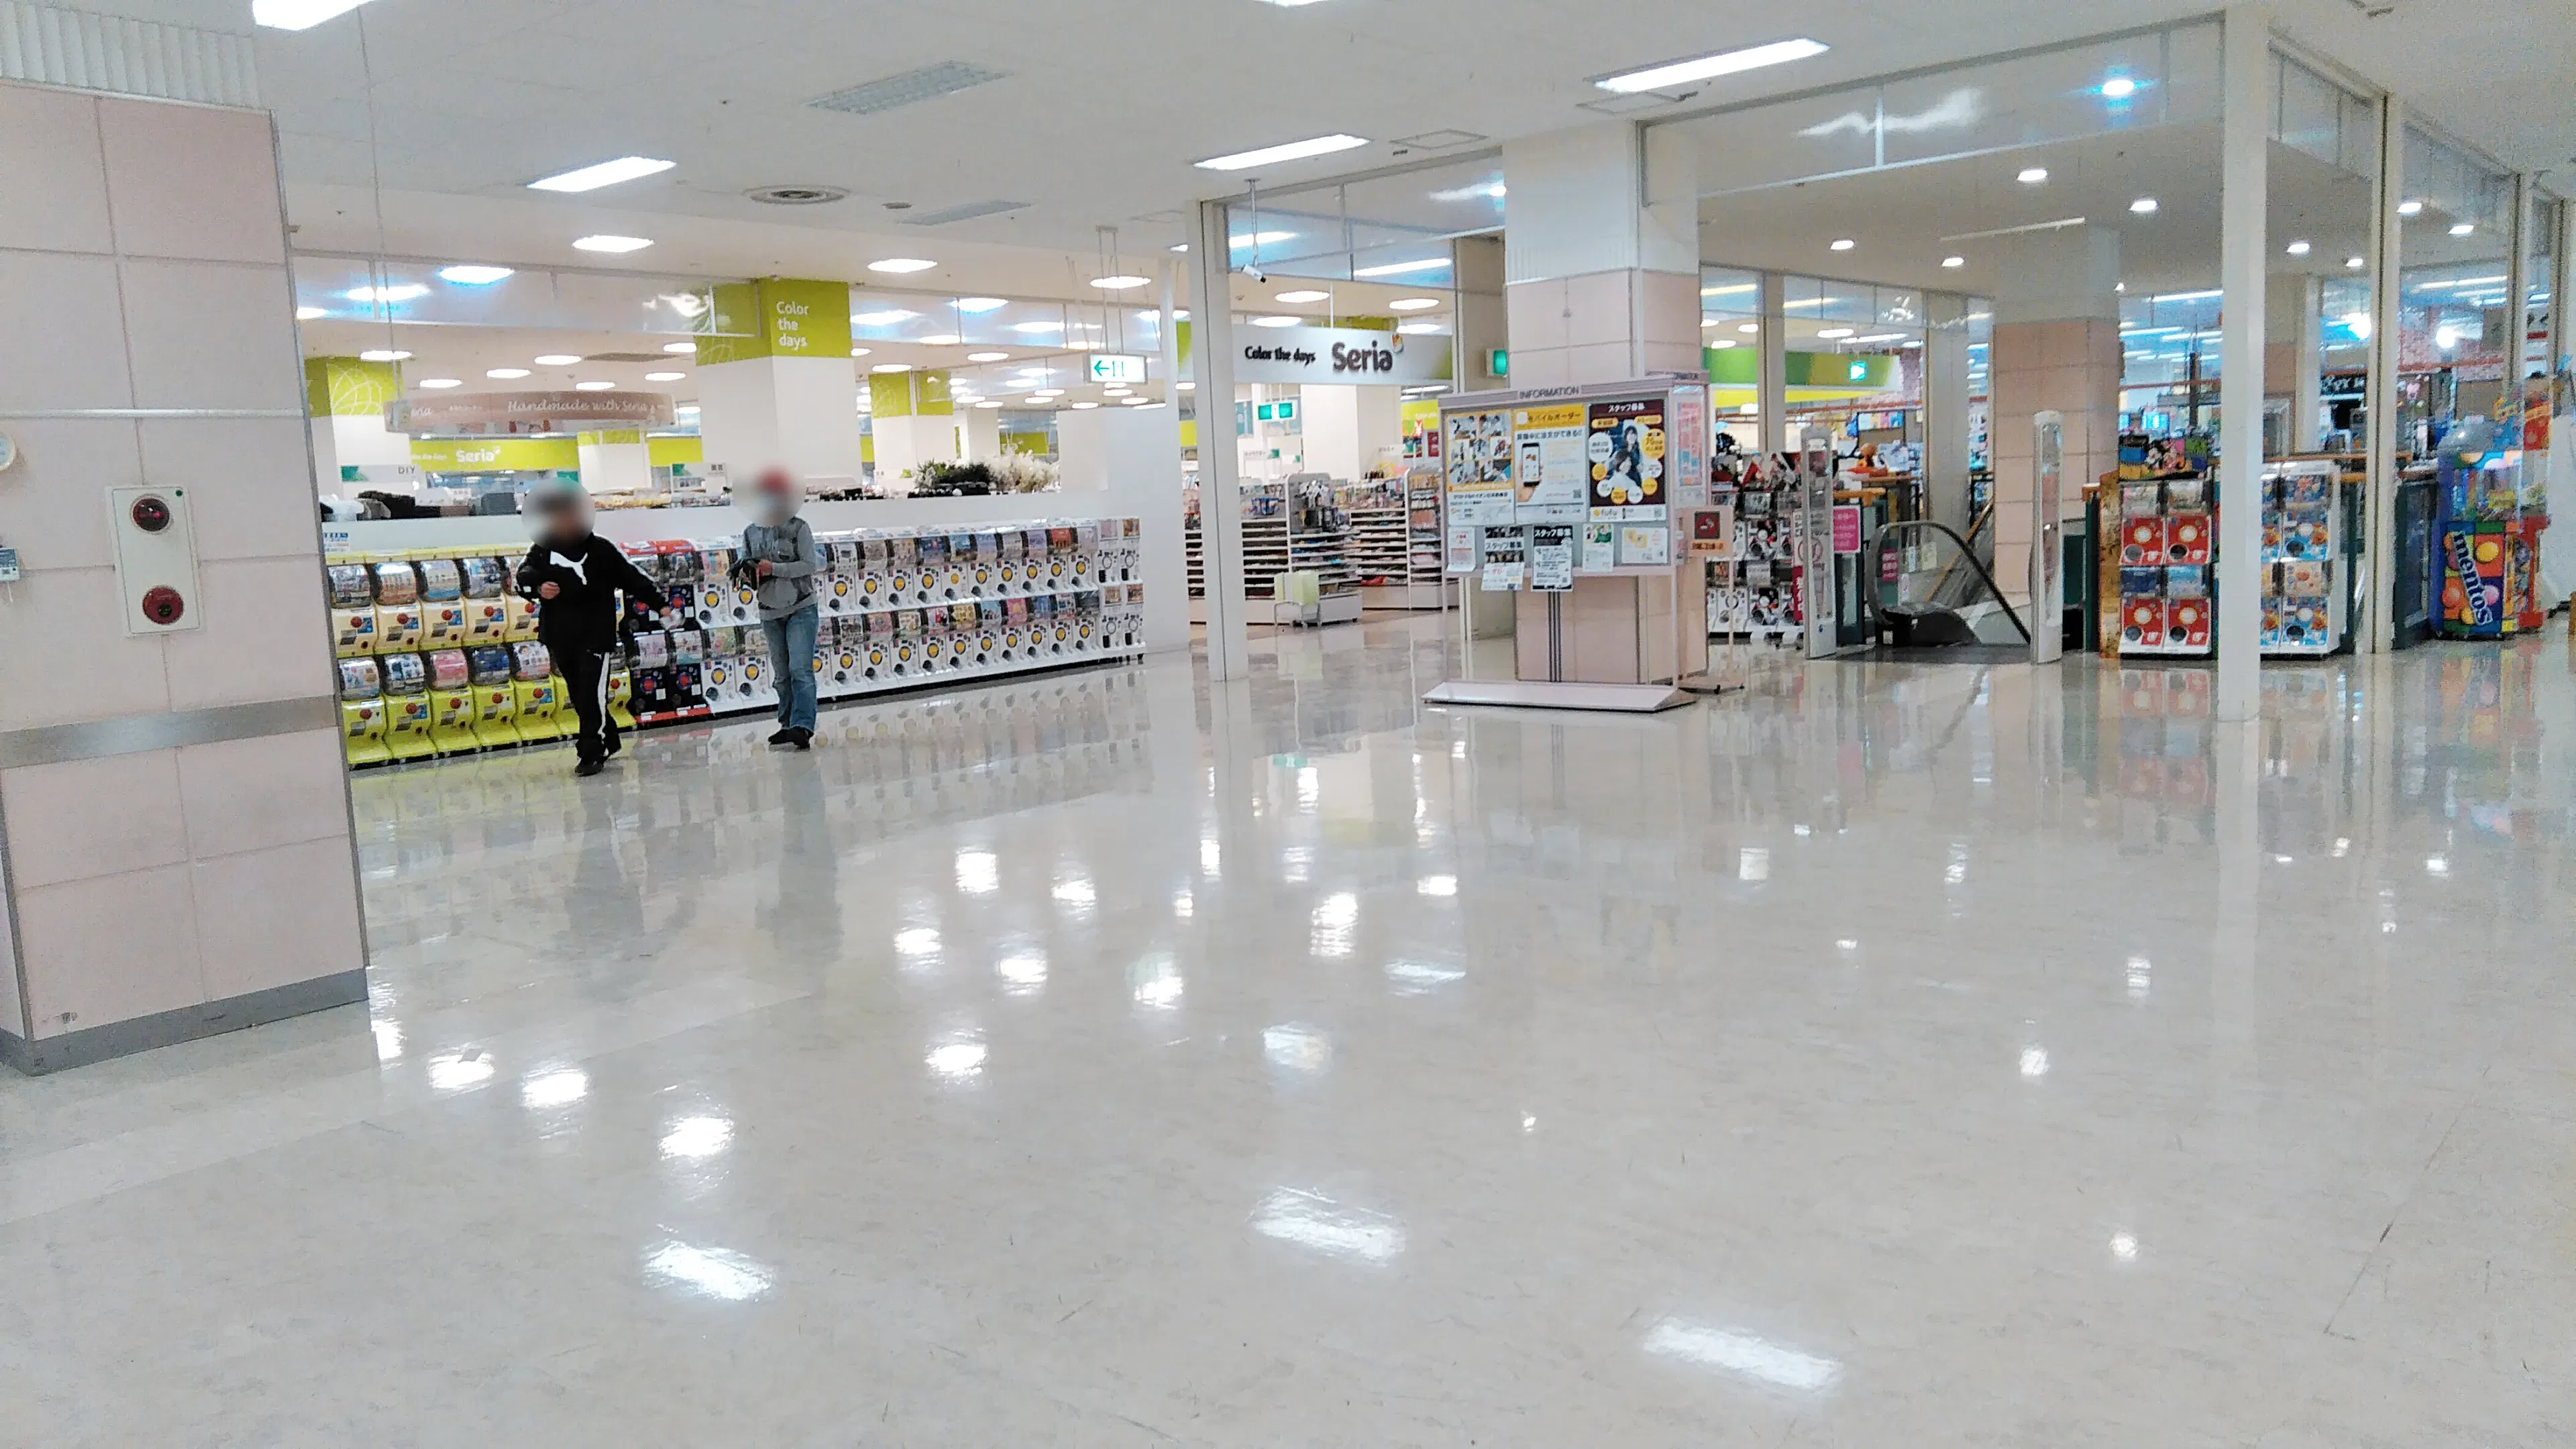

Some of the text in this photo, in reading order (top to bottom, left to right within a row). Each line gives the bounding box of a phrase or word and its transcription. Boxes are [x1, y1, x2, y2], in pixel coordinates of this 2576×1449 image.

[776, 301, 809, 315] Color
[777, 317, 798, 331] the
[779, 333, 808, 351] days
[1244, 345, 1316, 367] Color the days
[1332, 340, 1394, 372] Seria
[1519, 386, 1579, 399] INFORMATION
[508, 399, 590, 413] Handmade
[592, 399, 619, 411] with
[455, 447, 496, 463] Seria
[398, 466, 415, 475] DIY
[1534, 528, 1572, 537] スタッフ募集
[1485, 541, 1522, 550] スタッフ募集
[2453, 530, 2493, 627] mentos
